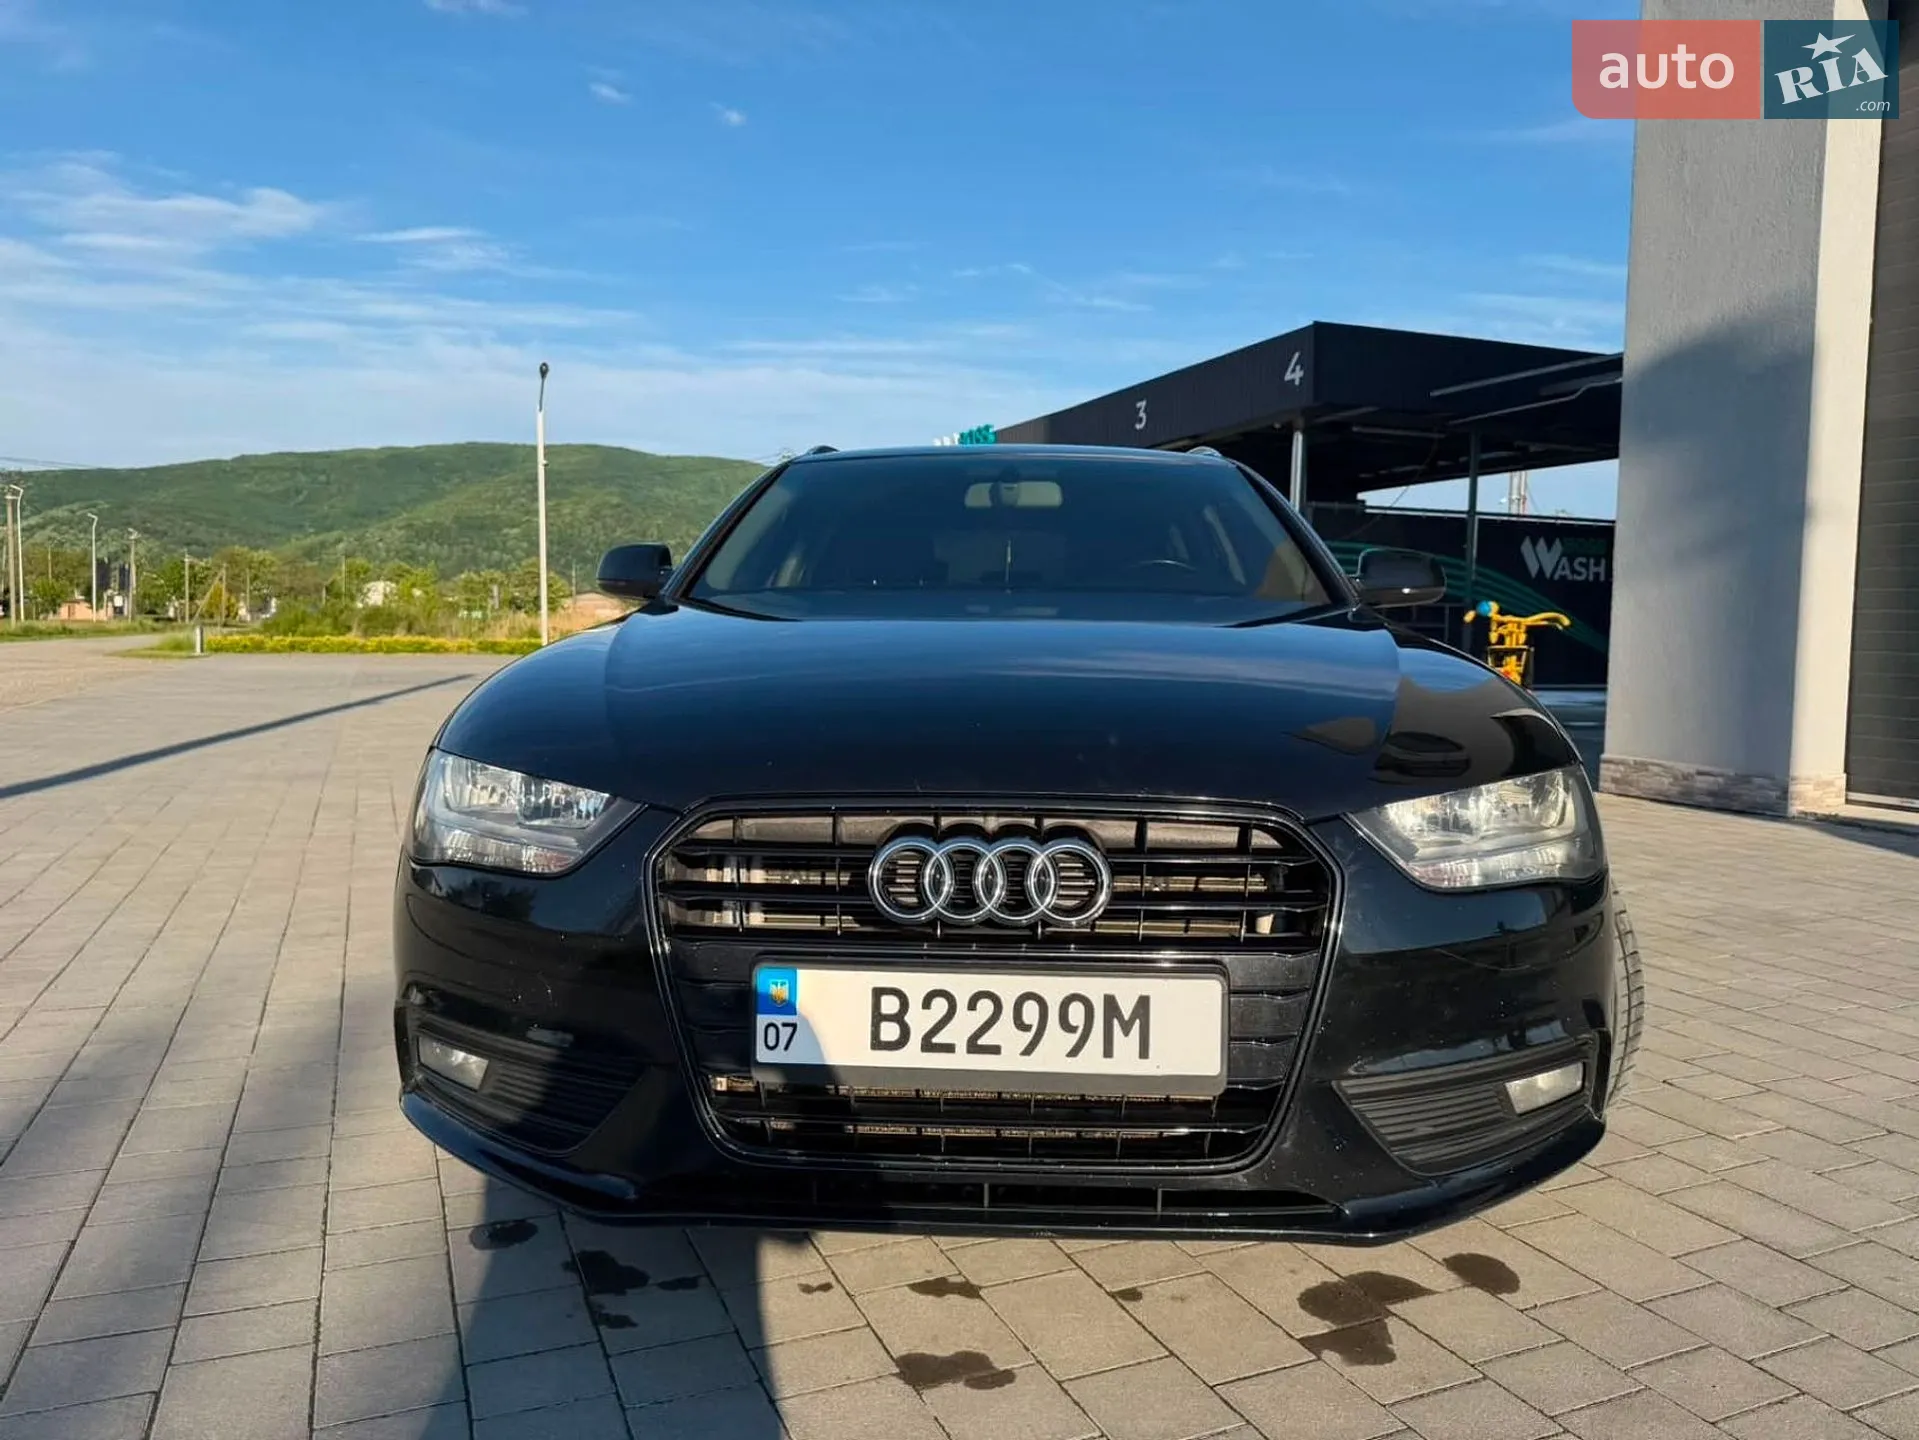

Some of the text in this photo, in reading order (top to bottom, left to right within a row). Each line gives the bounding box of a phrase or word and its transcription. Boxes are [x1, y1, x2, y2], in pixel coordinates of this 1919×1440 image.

[1284, 352, 1304, 386] 4
[1135, 400, 1148, 430] 3
[1520, 536, 1606, 582] WASH
[763, 1022, 798, 1051] 07
[870, 986, 1151, 1060] B2299M
